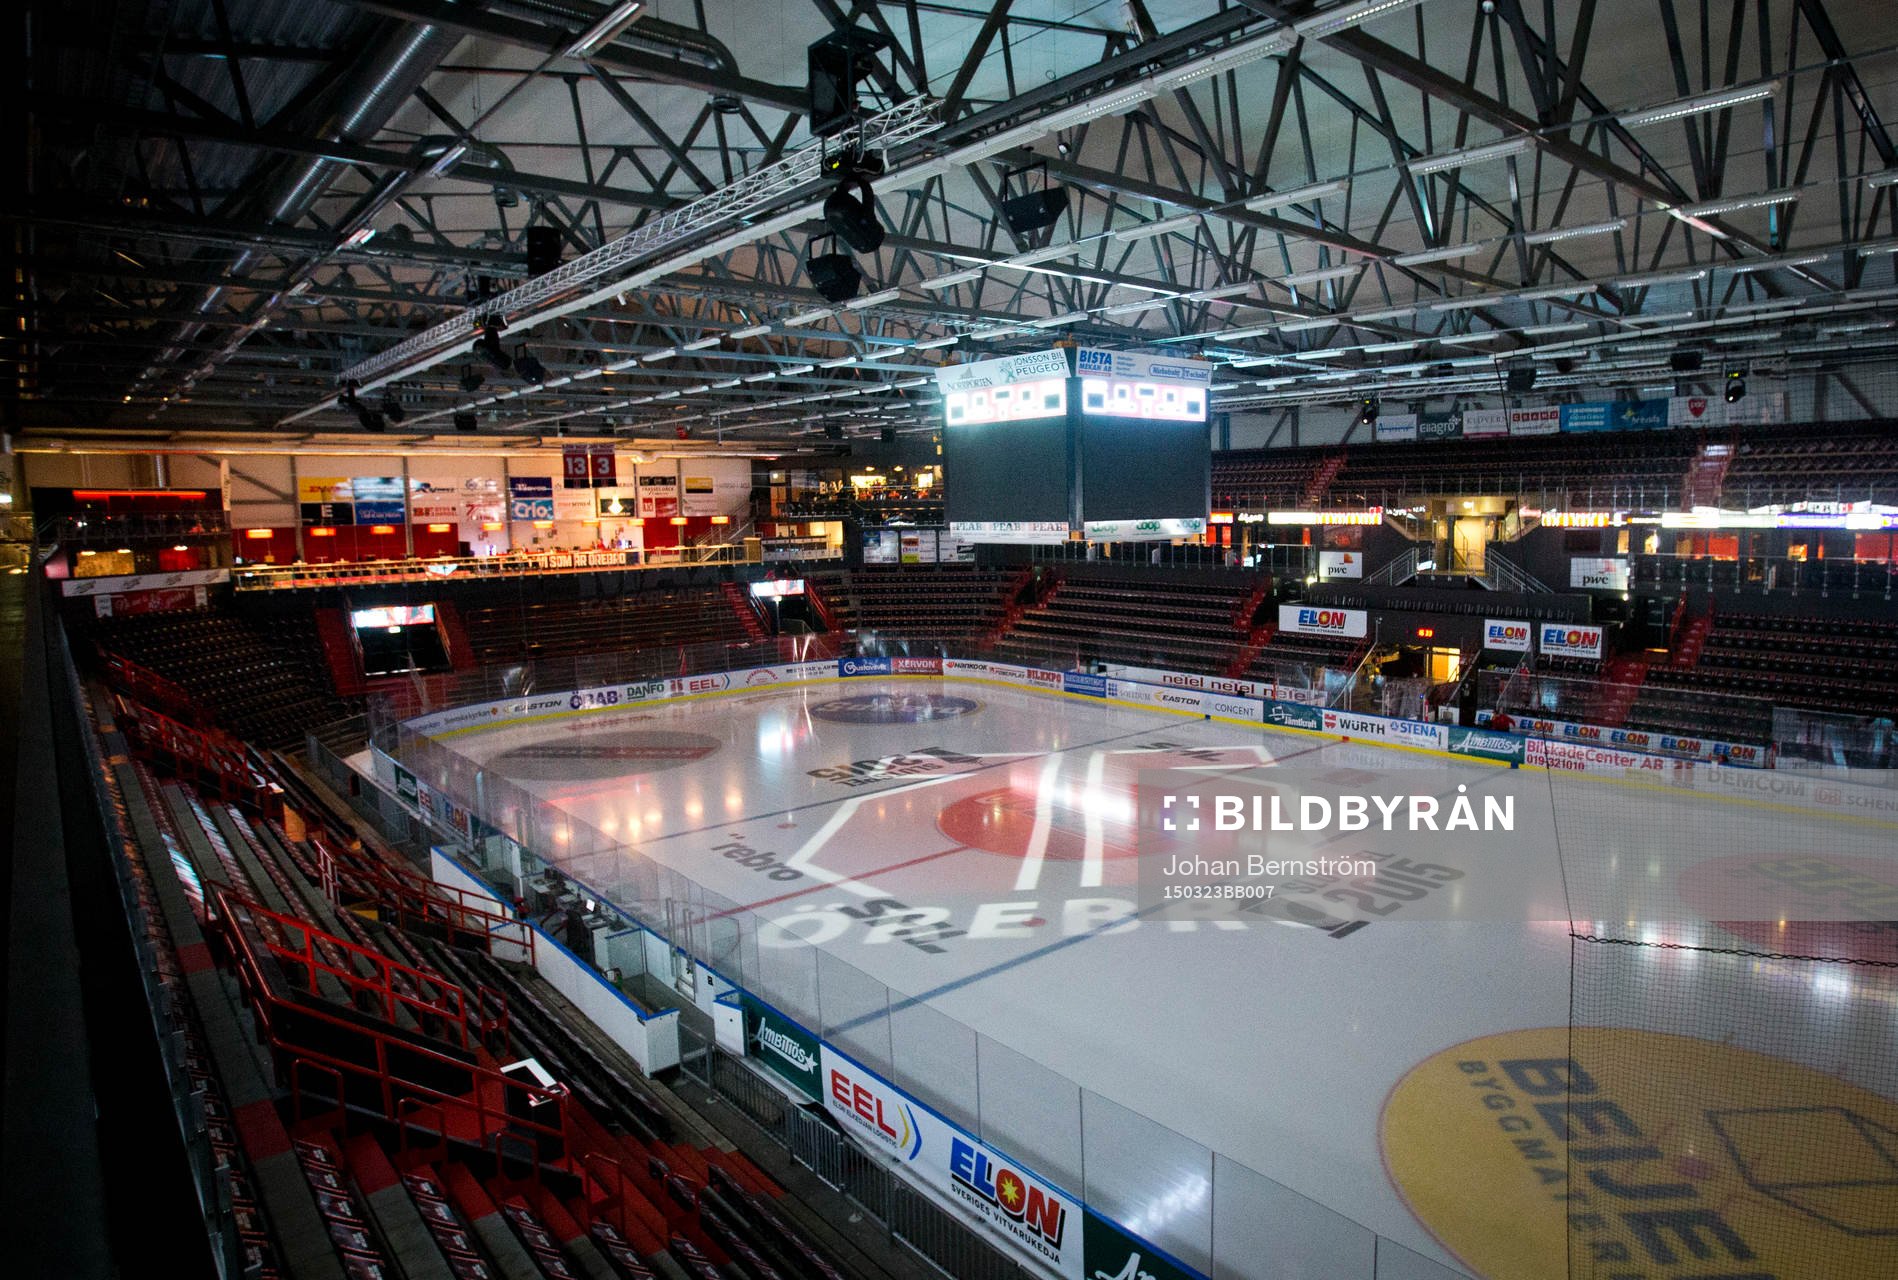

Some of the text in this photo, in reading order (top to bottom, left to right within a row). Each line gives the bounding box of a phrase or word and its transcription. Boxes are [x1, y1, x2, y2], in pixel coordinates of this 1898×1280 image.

[1051, 352, 1065, 361] BIL
[1079, 350, 1112, 365] BISTA
[1016, 362, 1066, 376] PEUGEOT
[566, 457, 586, 475] 13
[597, 457, 610, 475] 3
[992, 522, 1021, 531] PEAB
[1033, 522, 1063, 531] PEAB
[1328, 565, 1348, 575] pwc
[1582, 574, 1609, 586] pwc
[1298, 609, 1347, 629] ELON
[1488, 625, 1527, 640] ELON
[1543, 628, 1600, 649] ELON
[898, 659, 936, 668] XERVON
[627, 682, 665, 699] DANFO
[689, 679, 720, 691] EEL
[514, 700, 562, 712] EASTON
[1162, 695, 1200, 706] EASTON
[1214, 703, 1255, 716] CONCENT
[1340, 718, 1385, 735] WÜRTH
[1400, 722, 1438, 737] STENA
[1520, 719, 1554, 732] ELON
[1564, 725, 1600, 738] ELON
[1611, 731, 1649, 746] ELON
[1660, 735, 1702, 751] ELON
[1714, 743, 1757, 760] ELON
[1708, 771, 1806, 797] DEMCOM
[1819, 789, 1898, 812] DB SCHEN
[831, 1068, 897, 1139] EEL
[1500, 1057, 1775, 1280] BEIJE
[950, 1136, 1066, 1250] ELON
[951, 1183, 1061, 1265] SVERIGES VITVARUKEDJA
